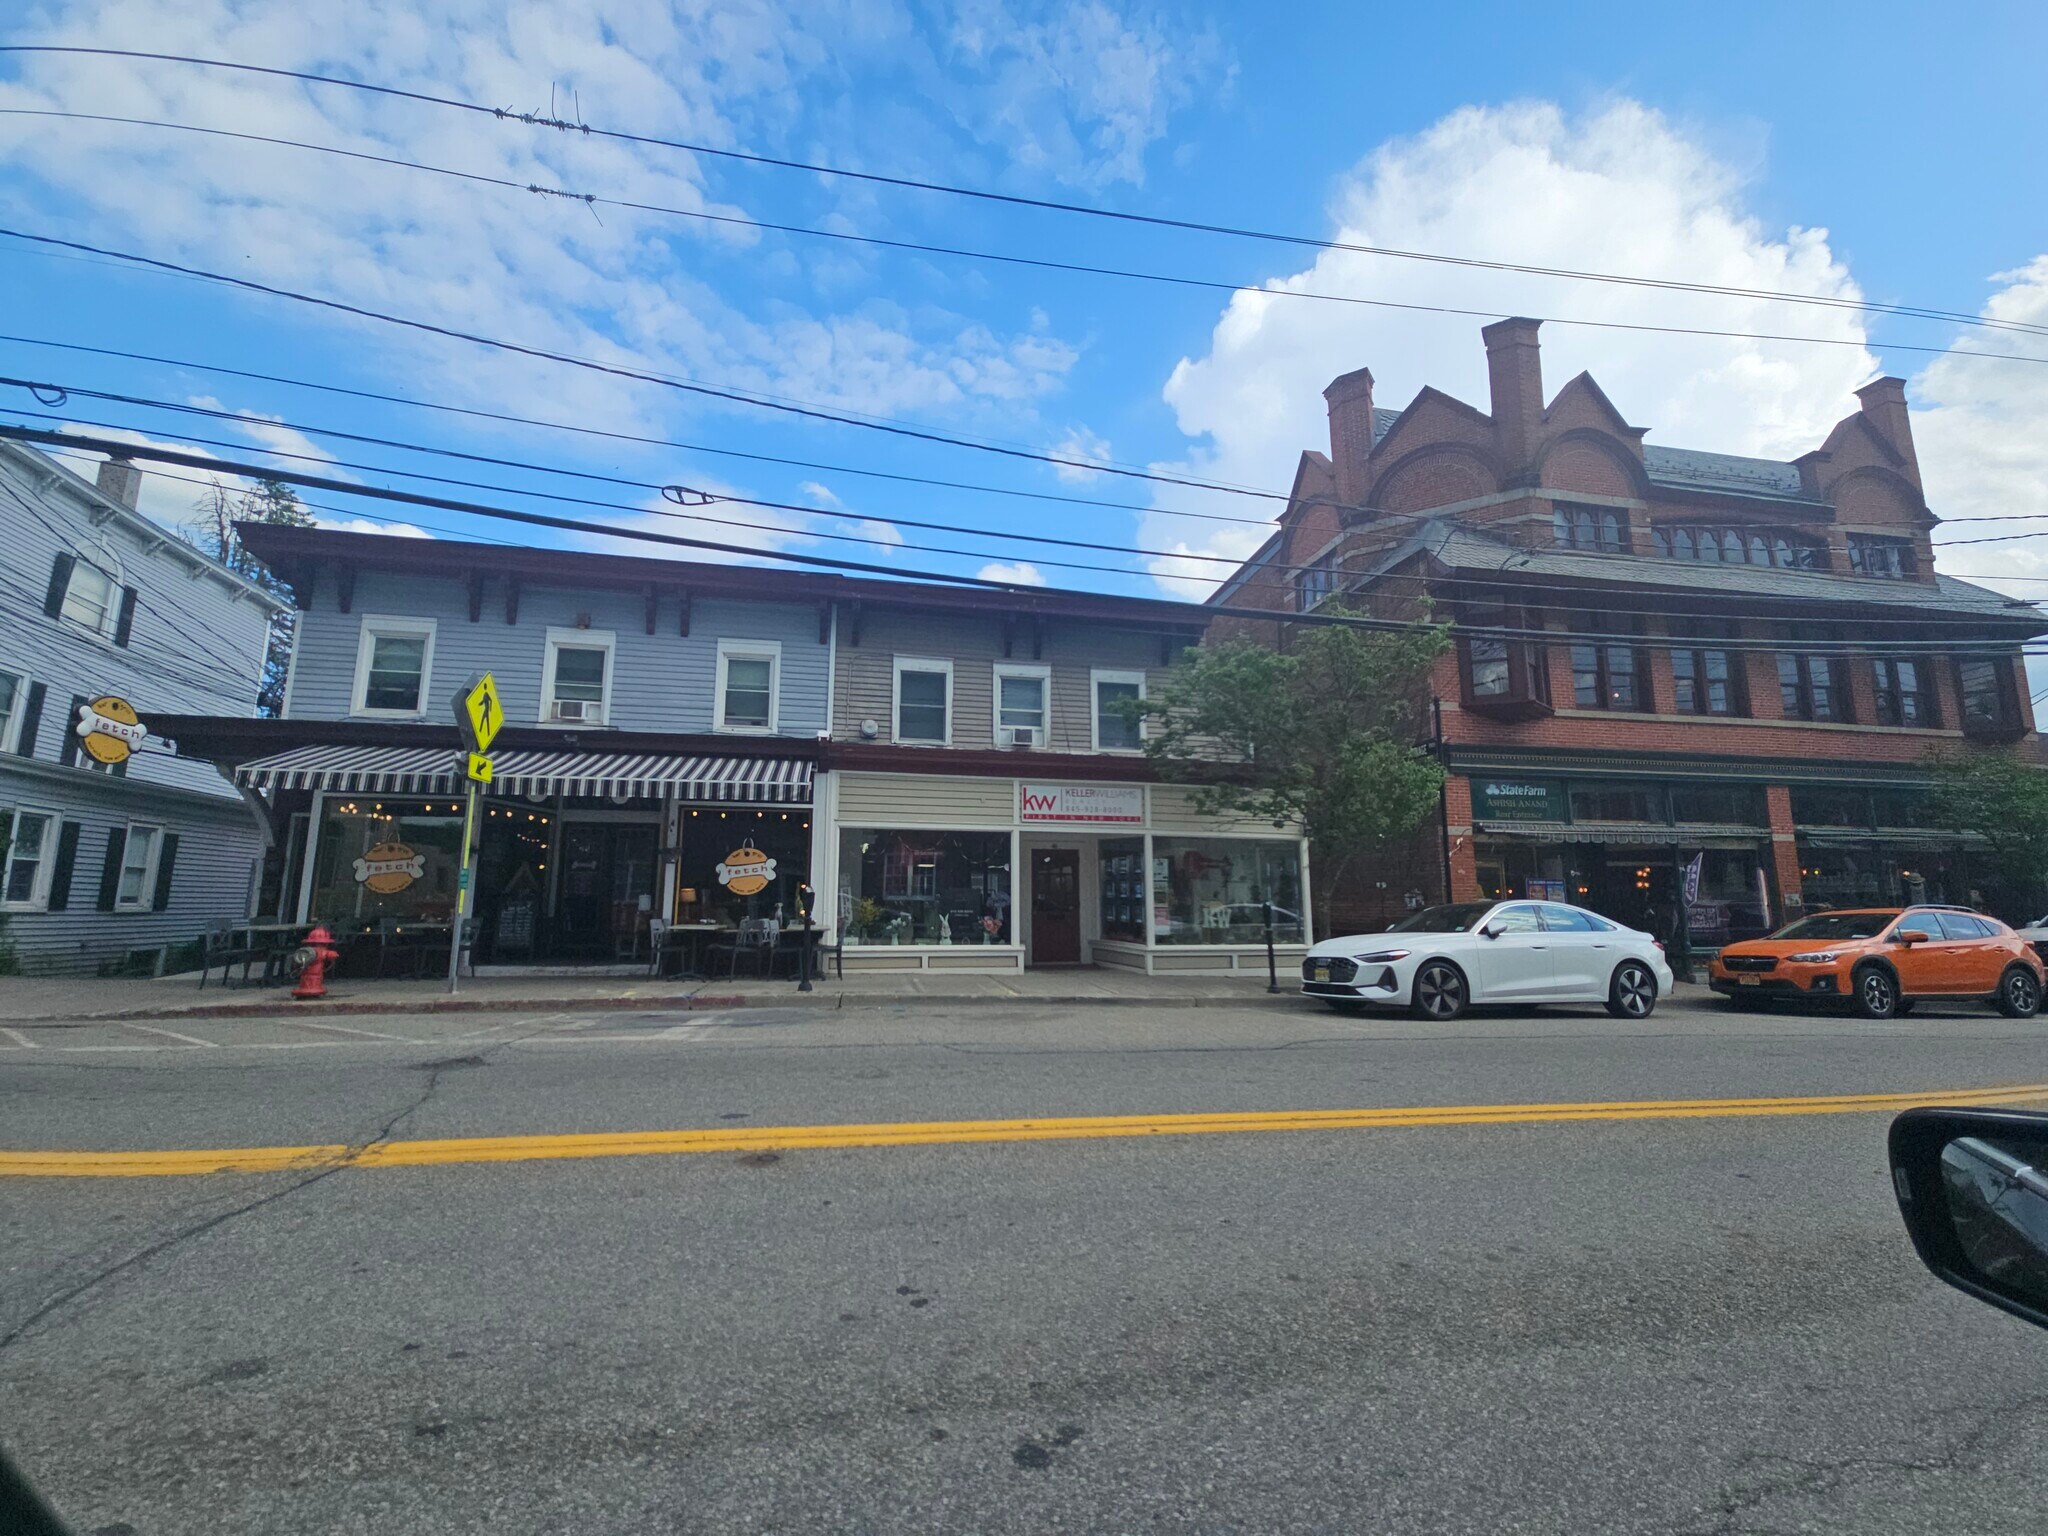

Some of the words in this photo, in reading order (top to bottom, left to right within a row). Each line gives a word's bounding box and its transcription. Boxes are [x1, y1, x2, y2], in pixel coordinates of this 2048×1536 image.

[95, 718, 140, 739] fetch
[1518, 799, 1548, 808] ANAND
[727, 864, 768, 875] fetch
